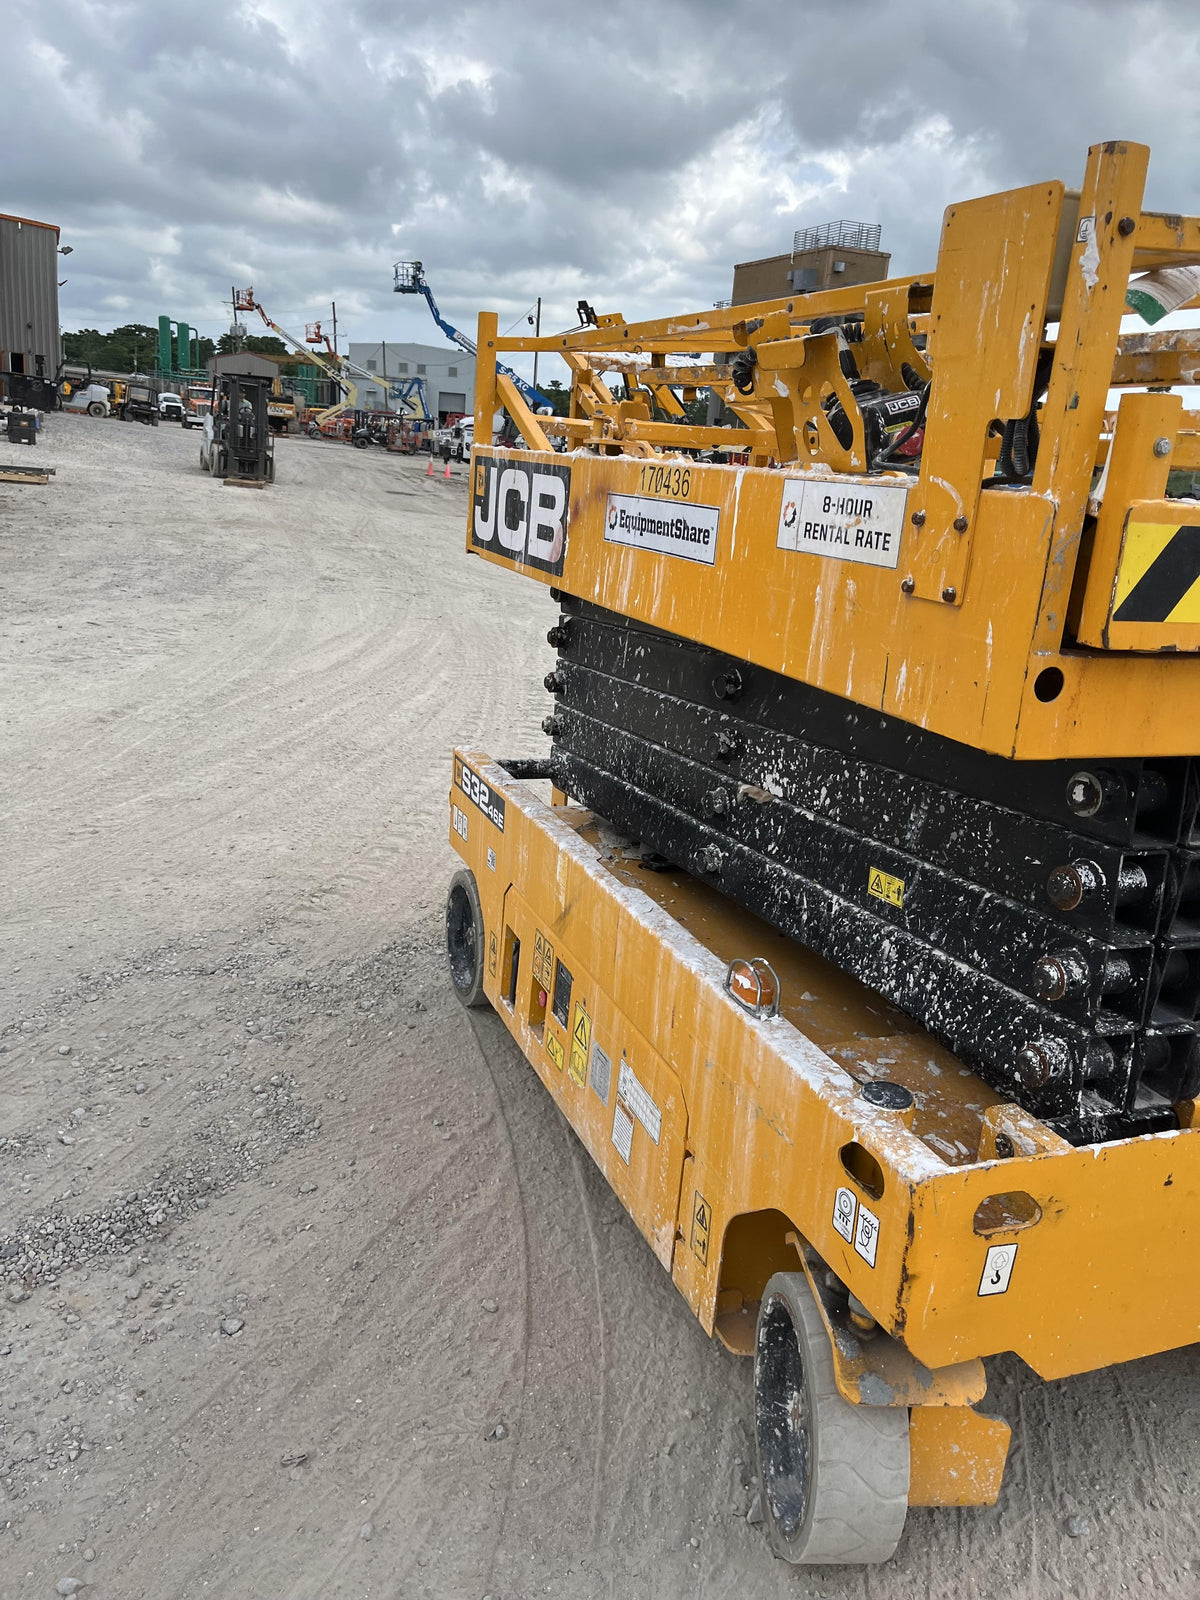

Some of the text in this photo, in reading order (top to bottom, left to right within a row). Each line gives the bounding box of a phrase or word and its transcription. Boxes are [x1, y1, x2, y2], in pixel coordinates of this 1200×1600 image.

[516, 379, 529, 391] XC
[890, 397, 919, 411] JCB
[641, 465, 691, 498] 170436
[474, 466, 566, 564] JCB
[822, 495, 873, 518] 8-HOUR
[618, 509, 711, 546] EquipmentShare
[803, 521, 892, 552] RENTAL RATE
[461, 765, 490, 815] S32
